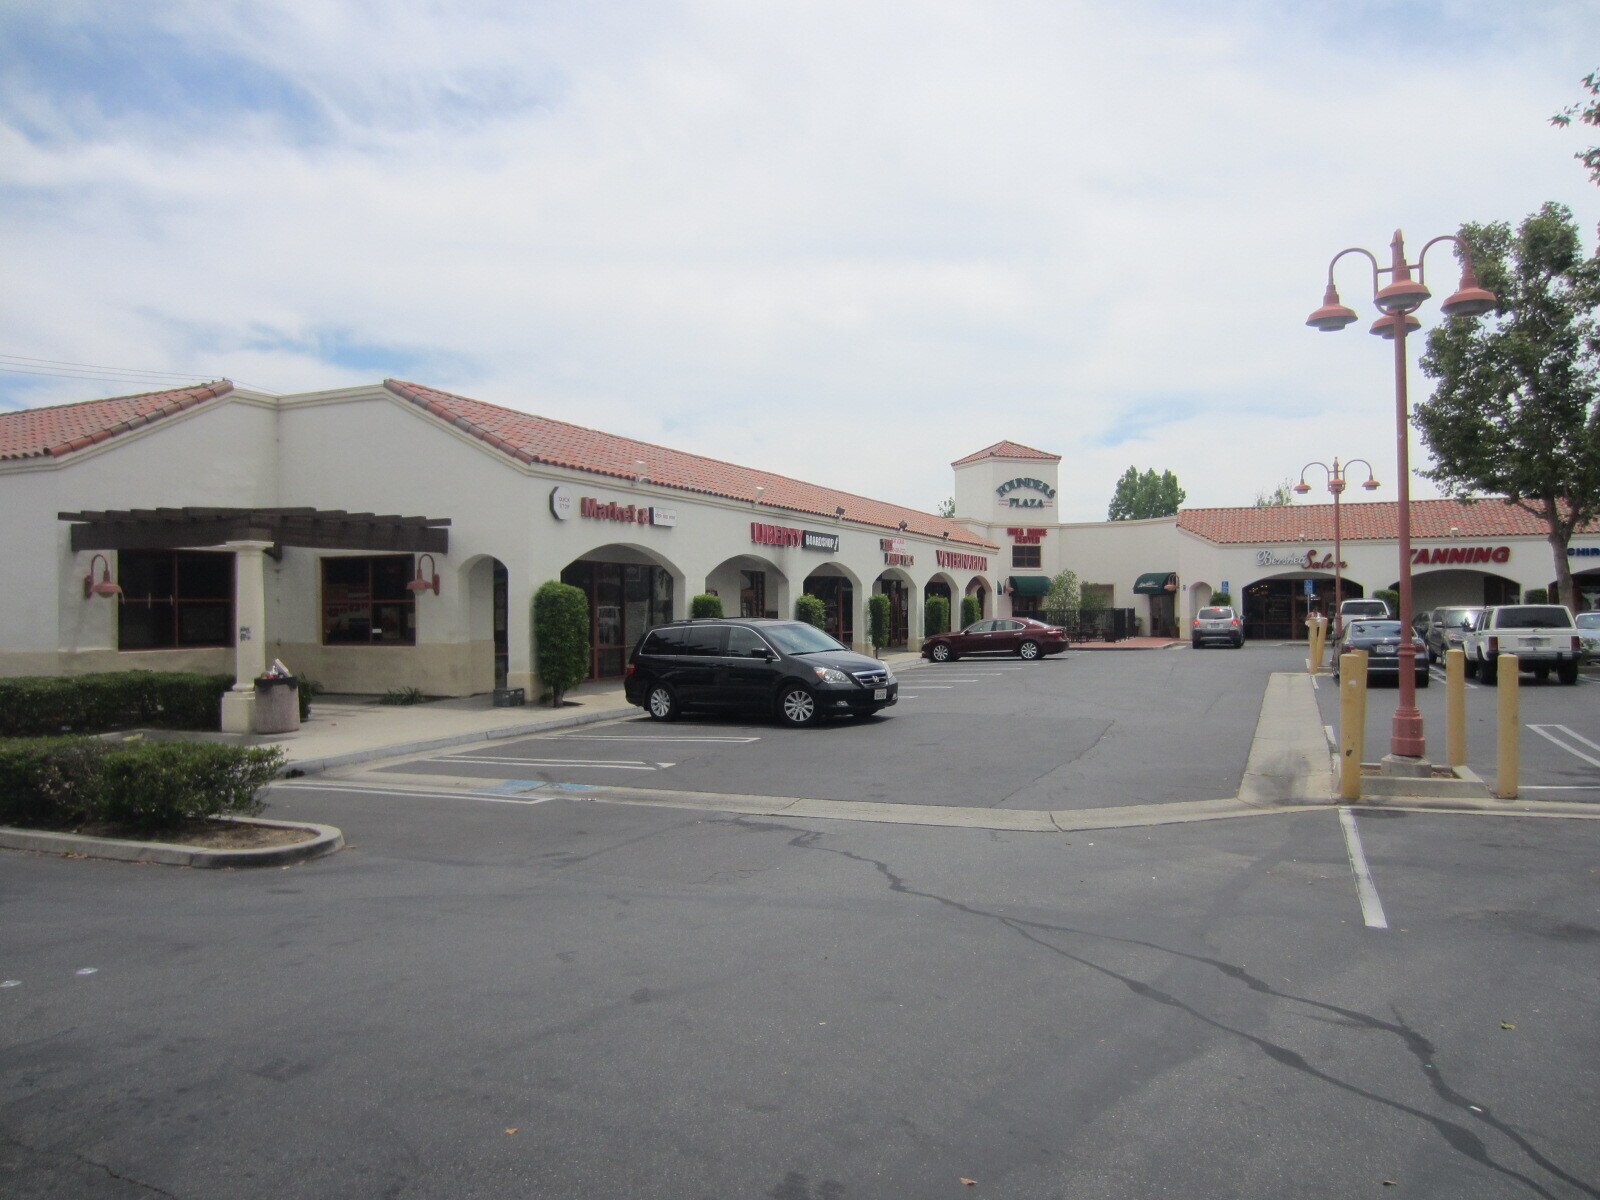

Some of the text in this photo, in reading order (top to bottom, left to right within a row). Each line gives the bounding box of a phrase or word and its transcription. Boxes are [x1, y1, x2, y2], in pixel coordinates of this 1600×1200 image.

[996, 477, 1056, 498] FOUNDERS
[581, 496, 636, 522] Market
[1009, 498, 1044, 508] PLAZA
[751, 522, 803, 547] LIBERTY
[936, 549, 987, 571] VETERINARIAN
[1301, 549, 1348, 569] Salon
